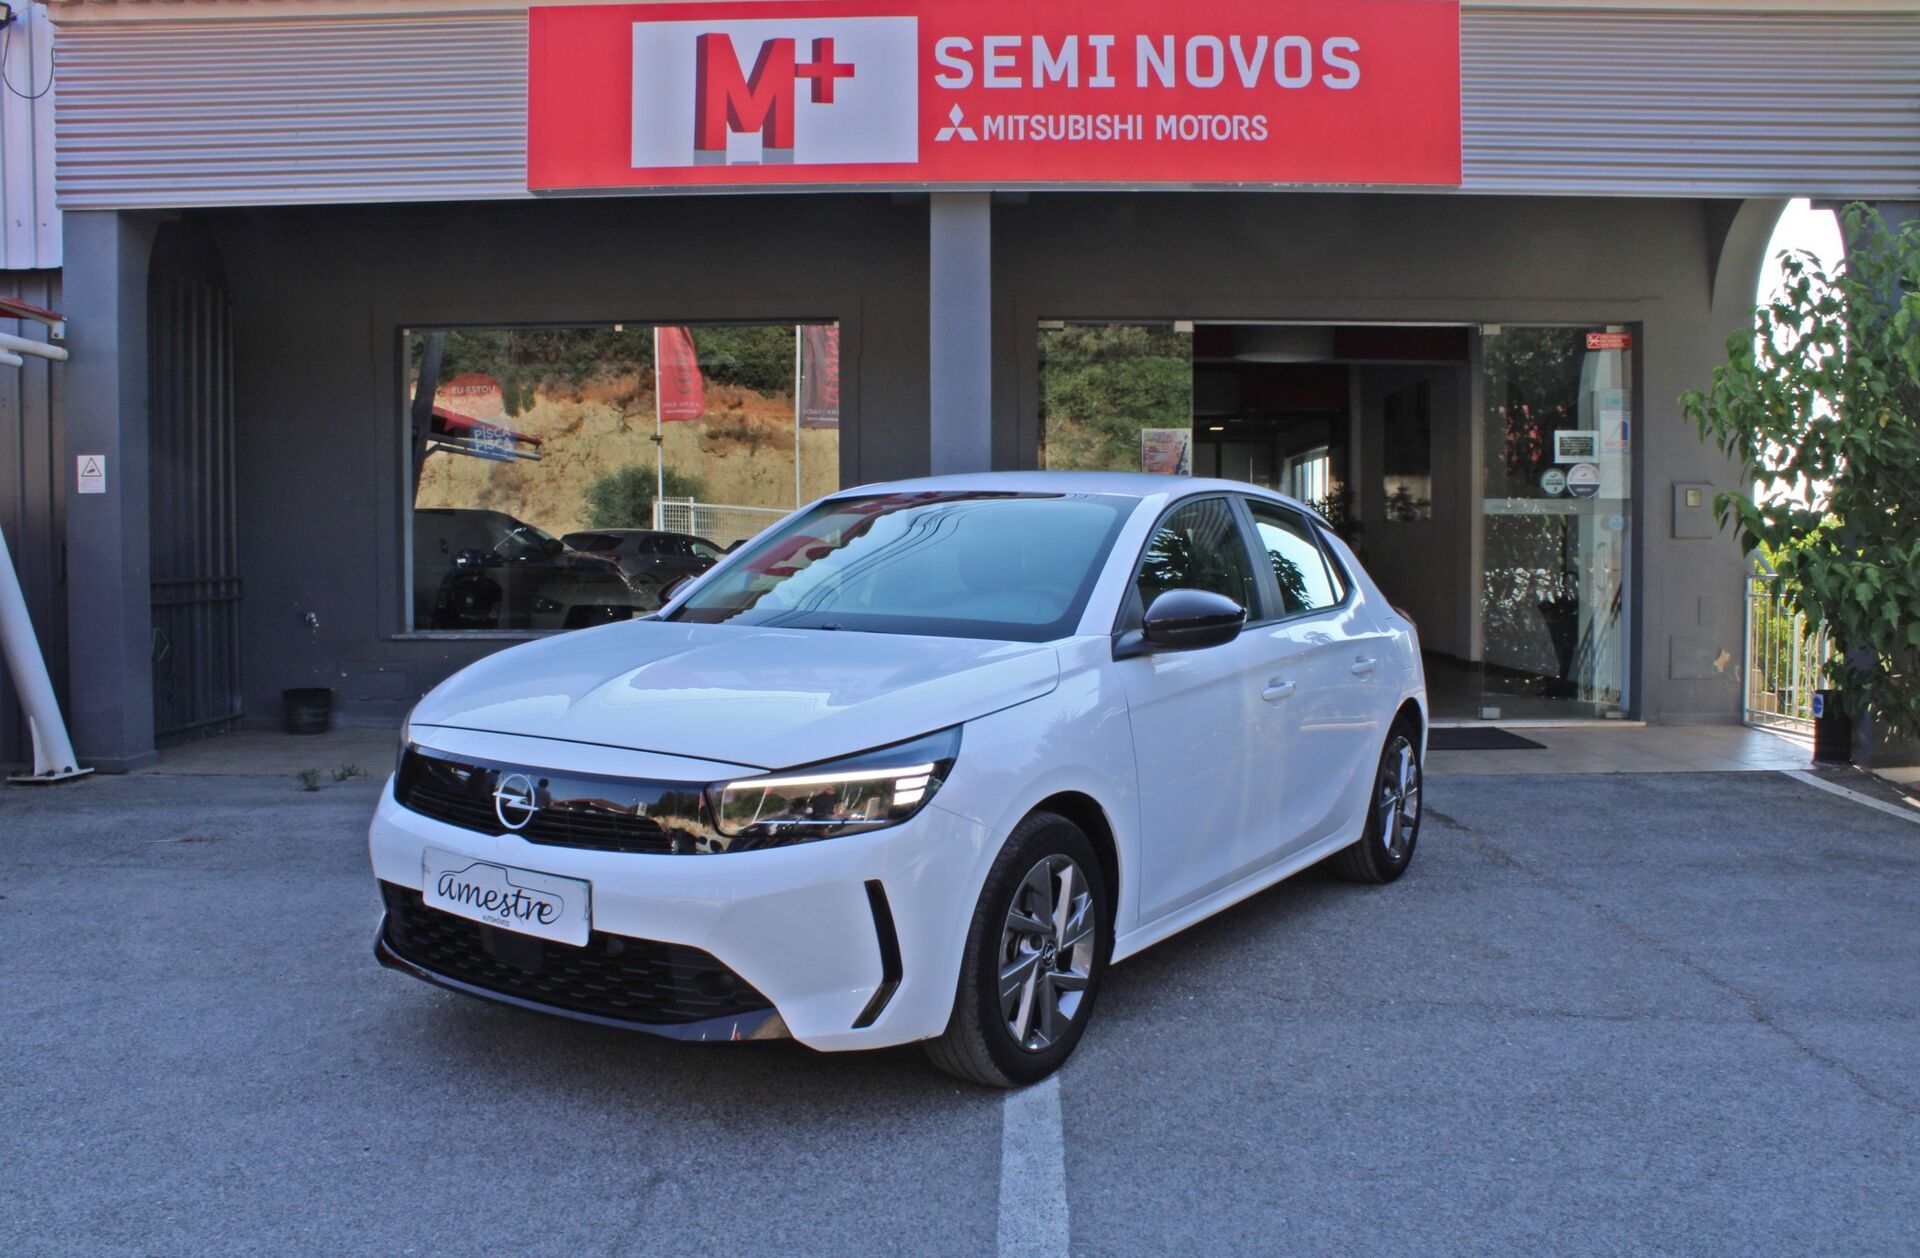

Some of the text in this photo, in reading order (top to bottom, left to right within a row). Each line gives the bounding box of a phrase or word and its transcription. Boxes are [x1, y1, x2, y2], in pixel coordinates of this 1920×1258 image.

[934, 35, 1361, 90] SEMI NOVOS
[983, 114, 1269, 141] MITSUBISHI MOTORS
[438, 873, 563, 925] amestre
